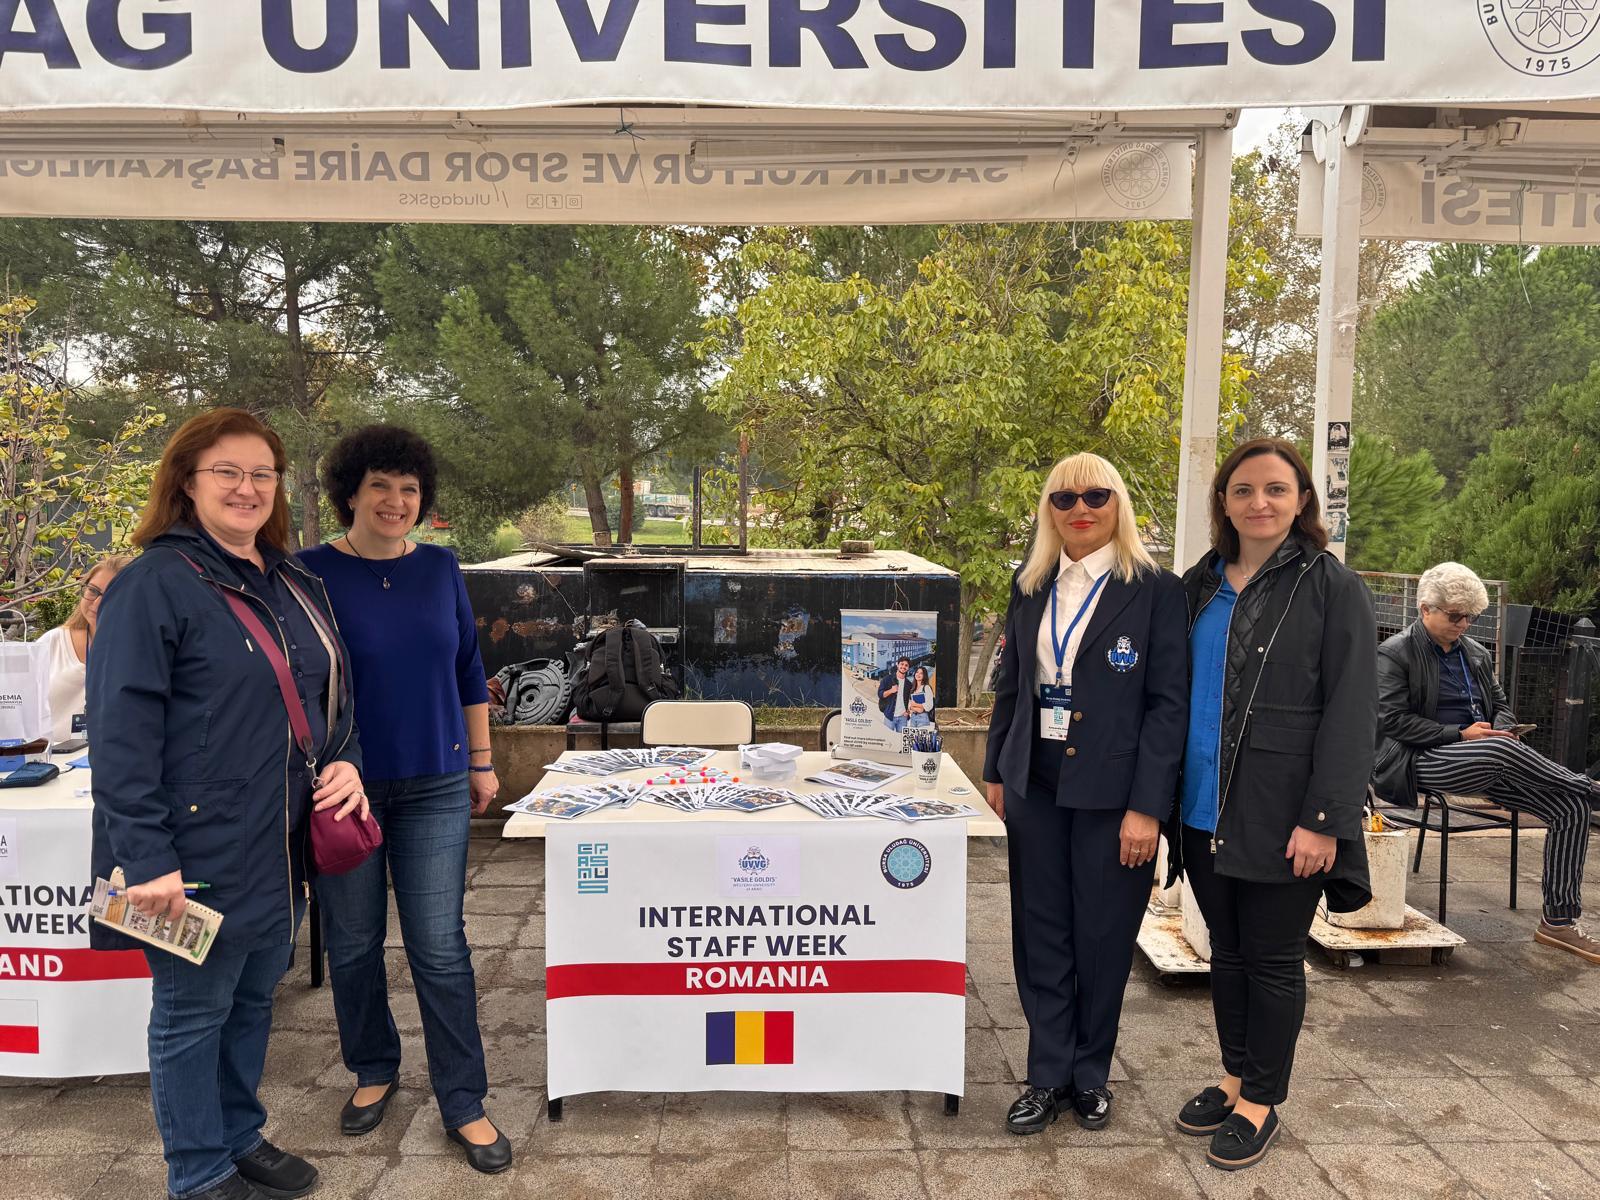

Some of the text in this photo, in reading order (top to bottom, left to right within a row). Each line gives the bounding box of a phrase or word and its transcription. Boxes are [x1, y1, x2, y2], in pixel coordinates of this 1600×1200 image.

[1525, 56, 1571, 72] 1975
[741, 860, 767, 869] UVVG
[0, 885, 94, 906] TIONA
[4, 912, 88, 935] WEEK
[639, 904, 876, 928] INTERNATIONAL
[667, 934, 848, 958] STAFF WEEK
[0, 953, 63, 978] AND
[686, 965, 829, 989] ROMANIA
